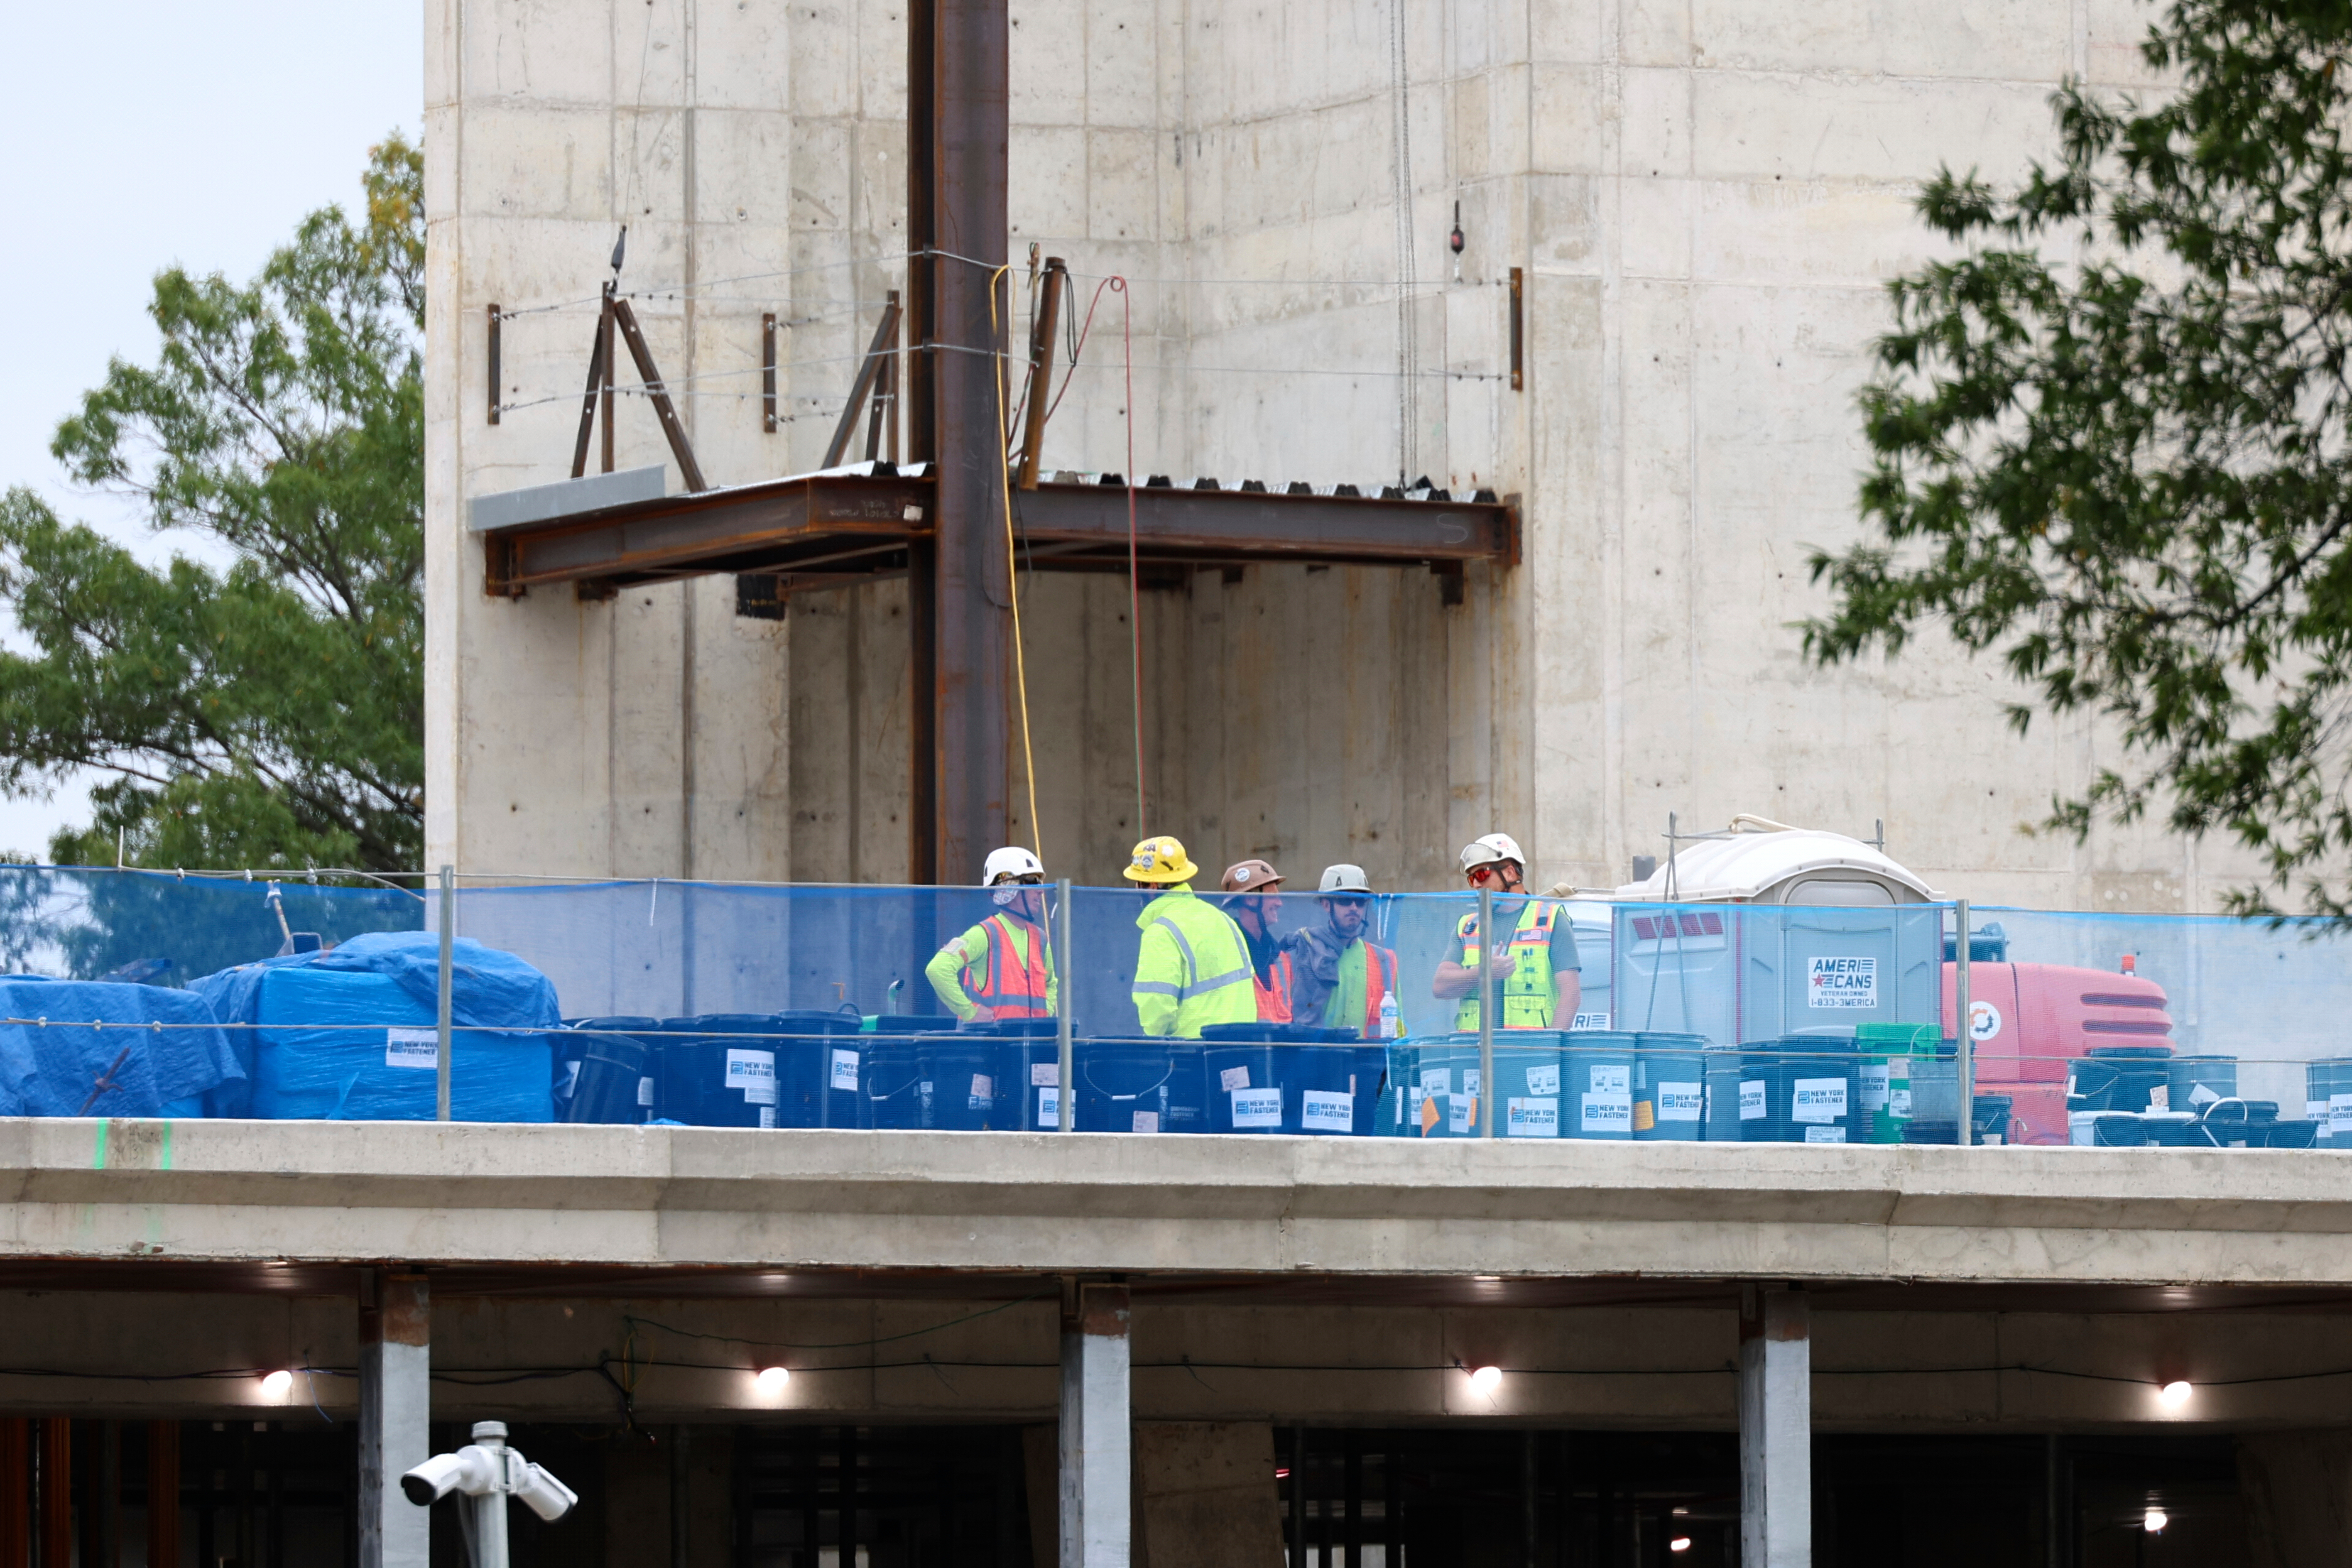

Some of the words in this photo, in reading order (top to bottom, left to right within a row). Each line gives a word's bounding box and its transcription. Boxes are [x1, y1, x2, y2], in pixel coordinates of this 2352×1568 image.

[1813, 959, 1861, 972] AMERI
[1834, 975, 1873, 989] CANS
[1811, 998, 1875, 1007] 1-833-3MERICA
[1810, 1096, 1843, 1104] FASTENER
[1320, 1110, 1350, 1119] FASTENER
